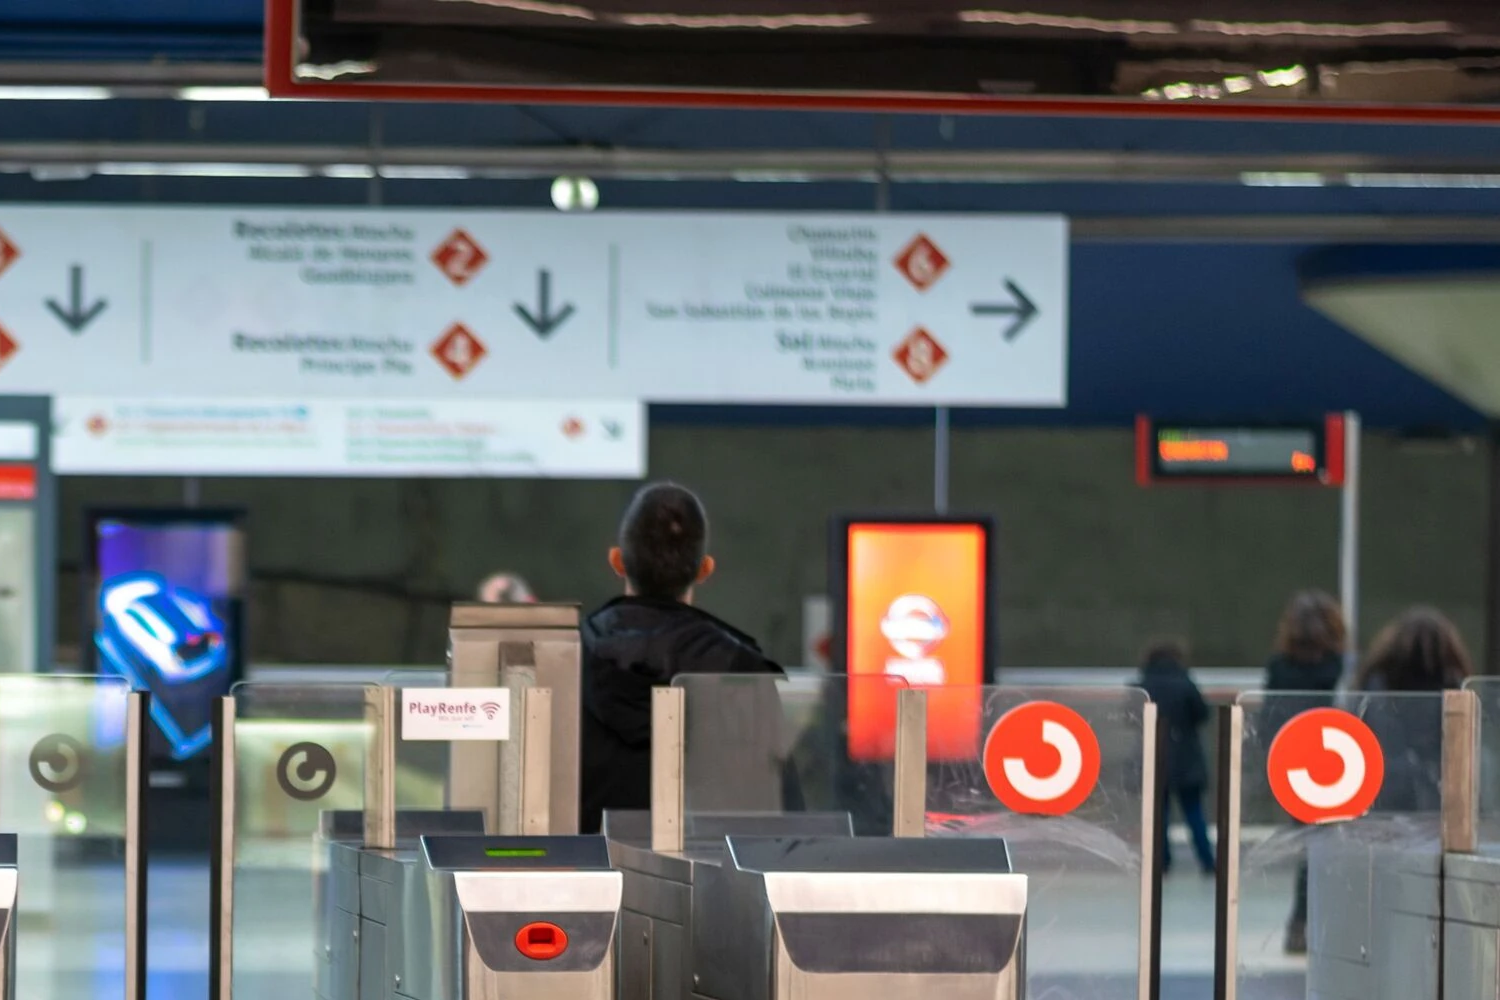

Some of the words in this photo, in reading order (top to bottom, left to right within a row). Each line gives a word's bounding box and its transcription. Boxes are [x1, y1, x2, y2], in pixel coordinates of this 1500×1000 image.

[446, 240, 471, 276] 2
[908, 247, 933, 283] 6
[408, 701, 477, 717] PlayRenfe
